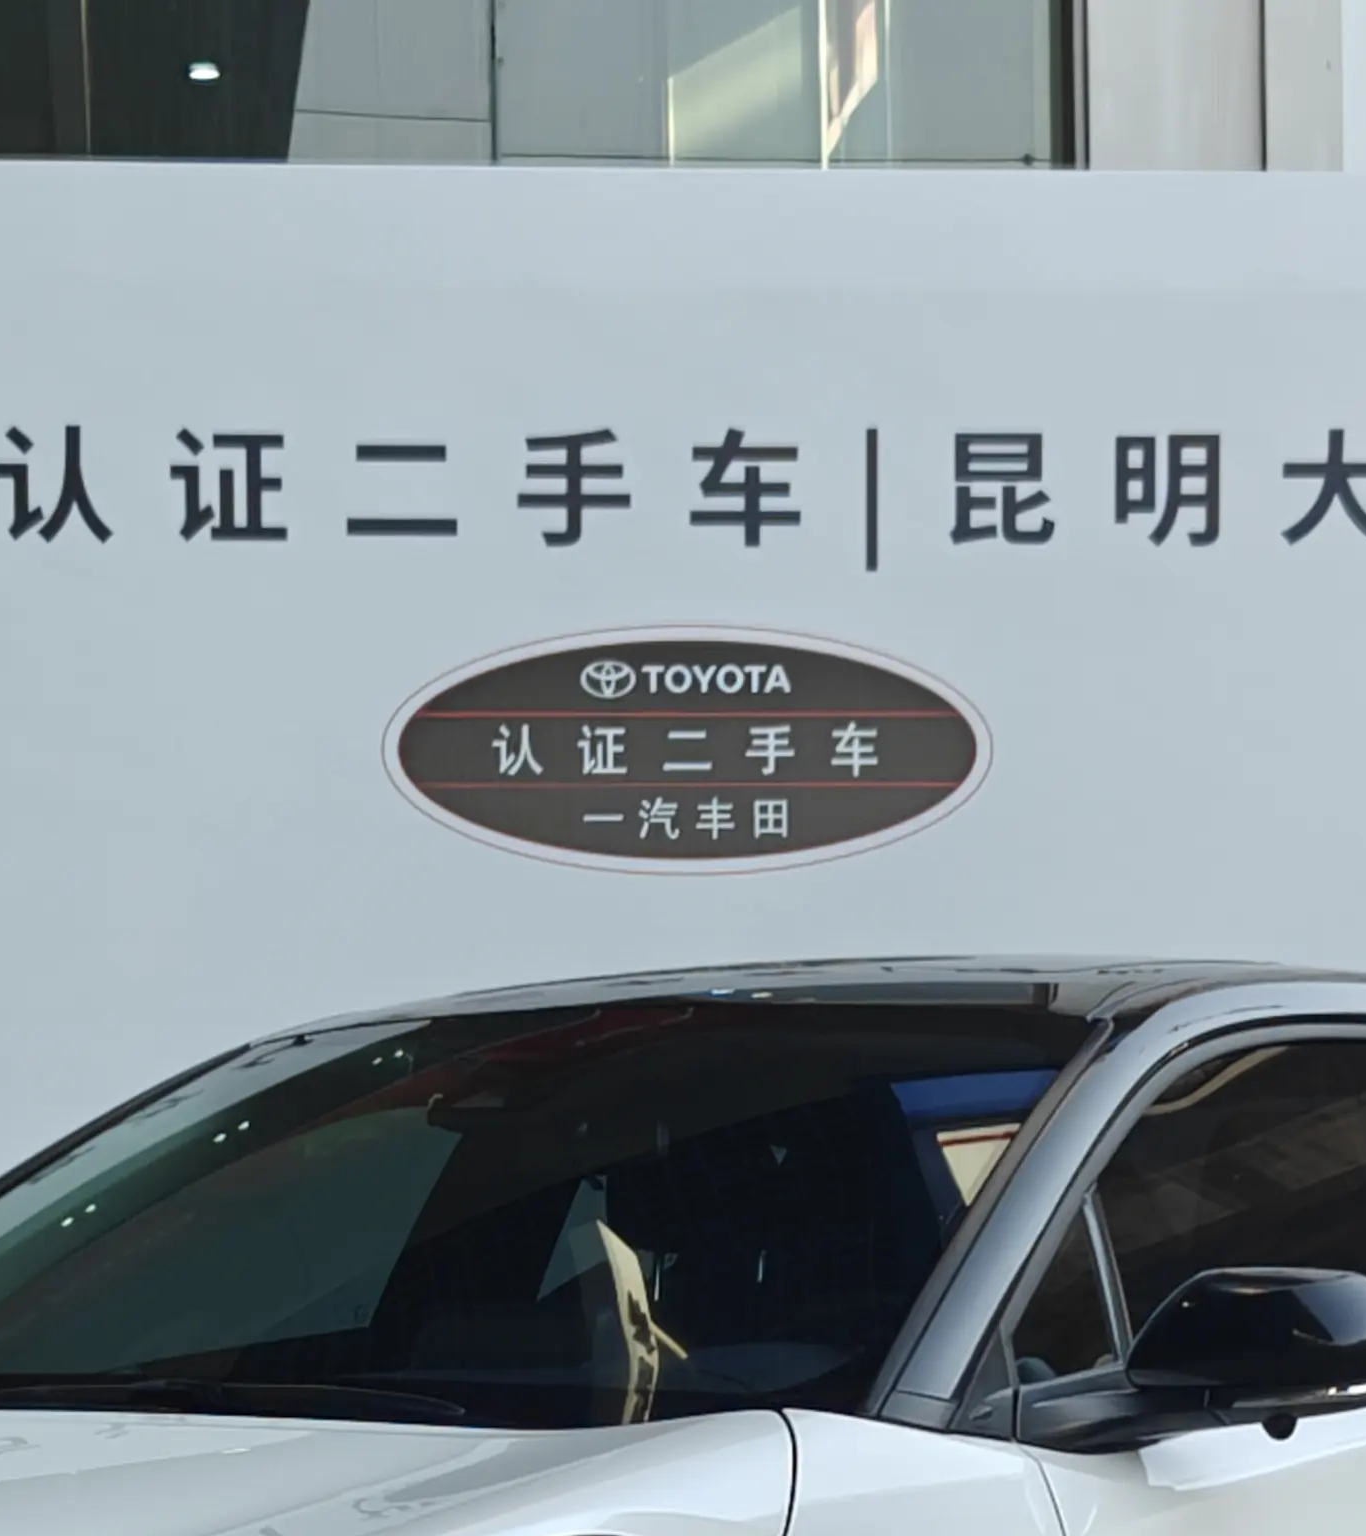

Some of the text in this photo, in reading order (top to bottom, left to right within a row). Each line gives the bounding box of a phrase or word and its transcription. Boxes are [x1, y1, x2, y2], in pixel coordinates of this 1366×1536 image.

[641, 664, 792, 694] TOYOTA
[491, 721, 880, 778] 认证二手车
[582, 796, 789, 840] 一汽丰田
